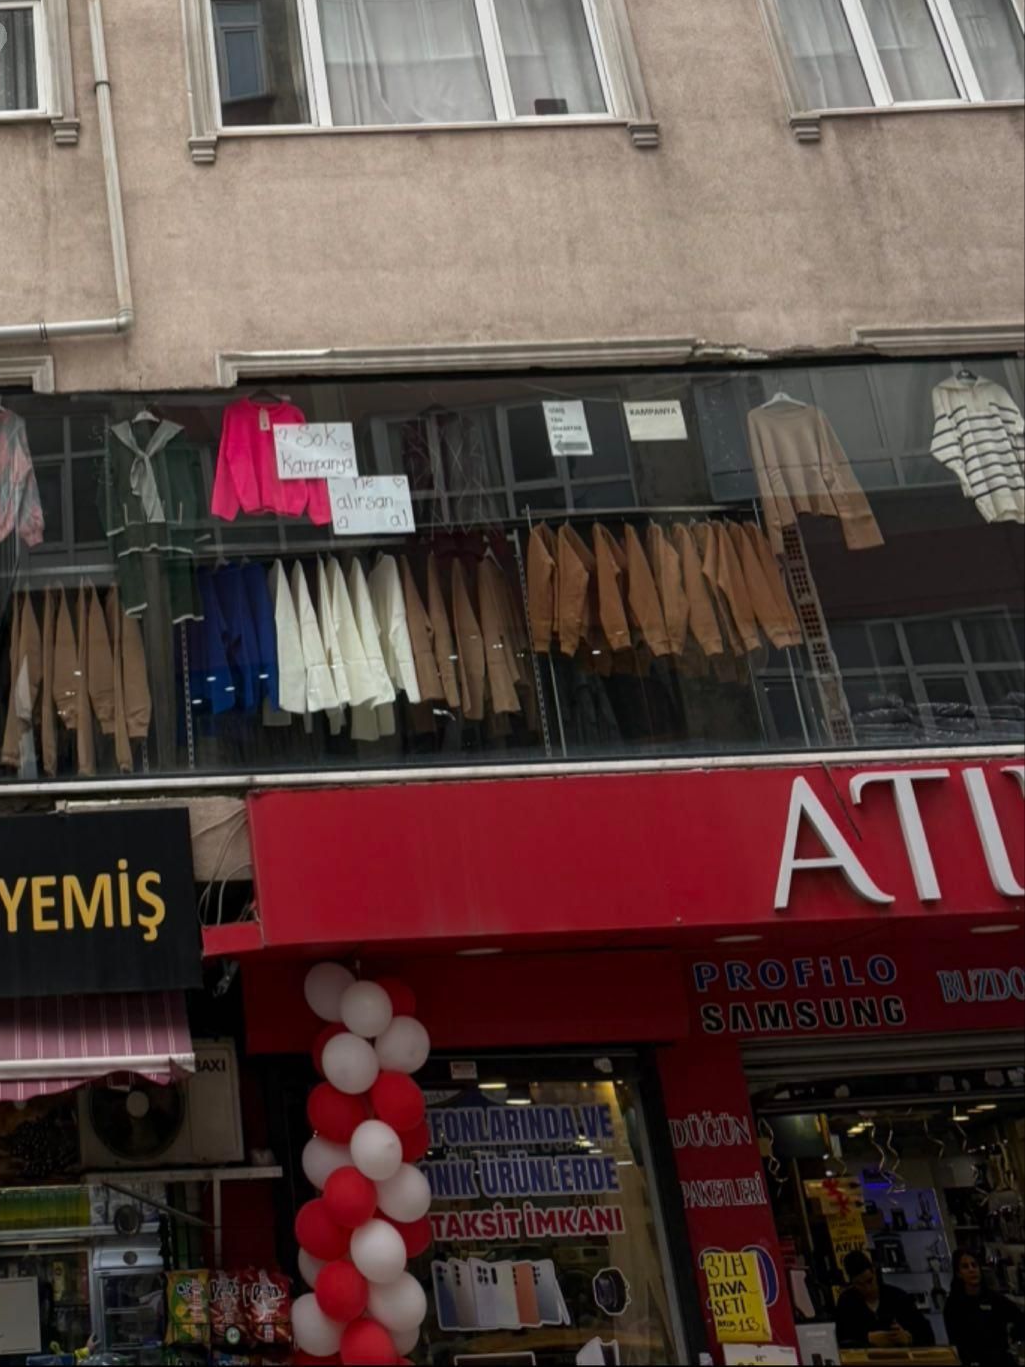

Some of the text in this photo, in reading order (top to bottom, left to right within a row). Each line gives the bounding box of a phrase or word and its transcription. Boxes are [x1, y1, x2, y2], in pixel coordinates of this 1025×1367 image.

[700, 995, 908, 1034] SAMSUNG
[429, 1104, 615, 1147] FONLARINDA VE
[668, 1111, 753, 1149] DÜĞÜN
[420, 1152, 622, 1198] ONİK ÜRÜNLERDE
[679, 1171, 768, 1210] PAKETLERİ
[430, 1201, 626, 1240] TAKSİT İMKANI
[709, 1280, 748, 1298] TAVA
